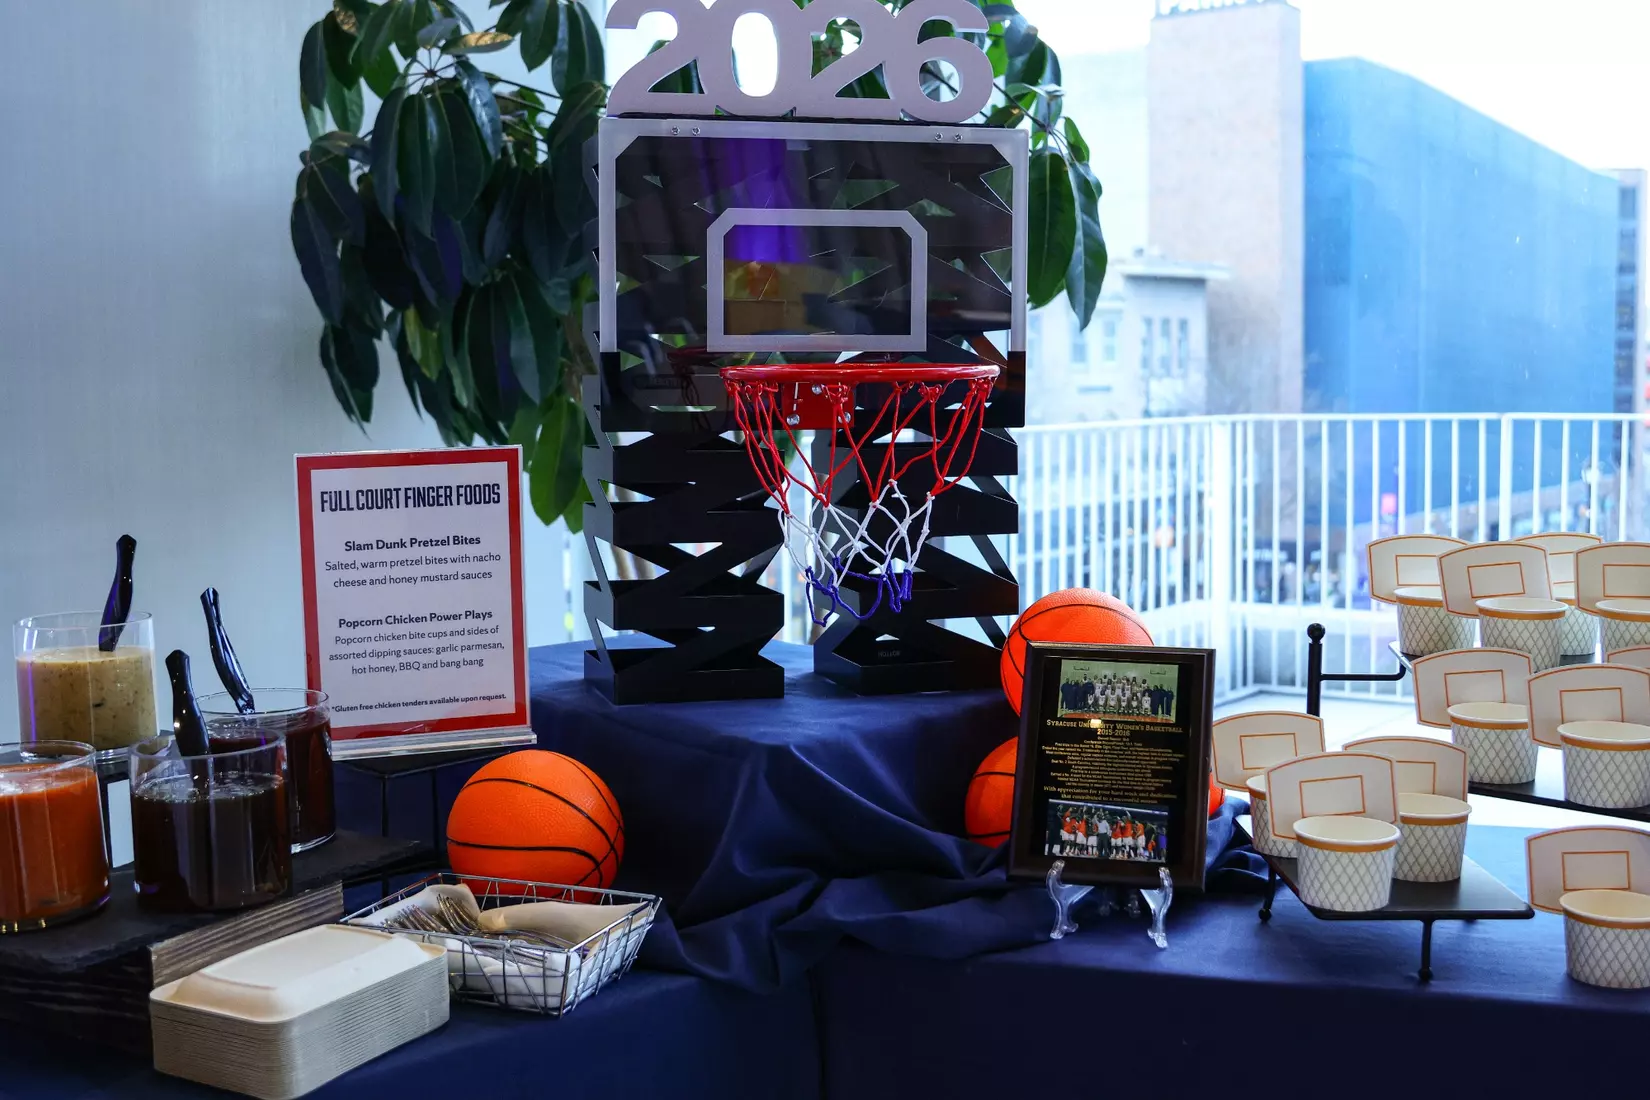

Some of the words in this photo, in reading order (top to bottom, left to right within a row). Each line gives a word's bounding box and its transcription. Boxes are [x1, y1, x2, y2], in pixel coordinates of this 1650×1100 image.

[605, 0, 994, 124] 2026
[320, 490, 354, 512] FULL
[356, 487, 402, 511] COURT
[404, 485, 453, 508] FINGER
[456, 483, 501, 506] FOODS
[344, 540, 374, 552] Slam
[376, 538, 407, 550] Dunk
[410, 536, 450, 548] Pretzel
[453, 535, 481, 546] Bites
[325, 560, 359, 571] Salted,
[361, 560, 388, 569] warm
[390, 556, 423, 569] pretzel
[425, 555, 448, 565] bites
[449, 553, 471, 563] with
[473, 552, 501, 562] nacho
[333, 577, 367, 588] cheese
[369, 575, 387, 585] and
[389, 573, 419, 585] honey
[420, 571, 459, 583] mustard
[461, 571, 492, 580] sauces
[338, 618, 383, 629] Popcorn
[385, 613, 428, 625] Chicken
[429, 612, 463, 623] Power
[464, 610, 493, 621] Plays
[335, 635, 372, 646] Popcorn
[374, 632, 407, 642] chicken
[409, 630, 426, 640] bite
[428, 631, 448, 640] cups
[449, 627, 466, 637] and
[467, 626, 489, 635] sides
[490, 625, 499, 634] of
[329, 651, 367, 661] assorted
[368, 648, 401, 660] dipping
[403, 647, 434, 656] sauces:
[436, 644, 459, 655] garlic
[461, 642, 505, 653] parmesan,
[352, 665, 367, 674] hot
[368, 663, 398, 674] honey,
[399, 661, 420, 671] BBQ
[422, 659, 438, 669] and
[440, 658, 461, 669] bang
[463, 657, 484, 667] bang
[359, 703, 373, 711] free
[374, 701, 401, 709] chicken
[402, 699, 428, 707] tenders
[429, 697, 460, 705] available
[460, 695, 478, 703] upon
[479, 693, 507, 702] request.
[1046, 719, 1077, 728] SYRACUSE
[1079, 720, 1114, 730] UNIITY
[1097, 728, 1131, 737] 2015-2016
